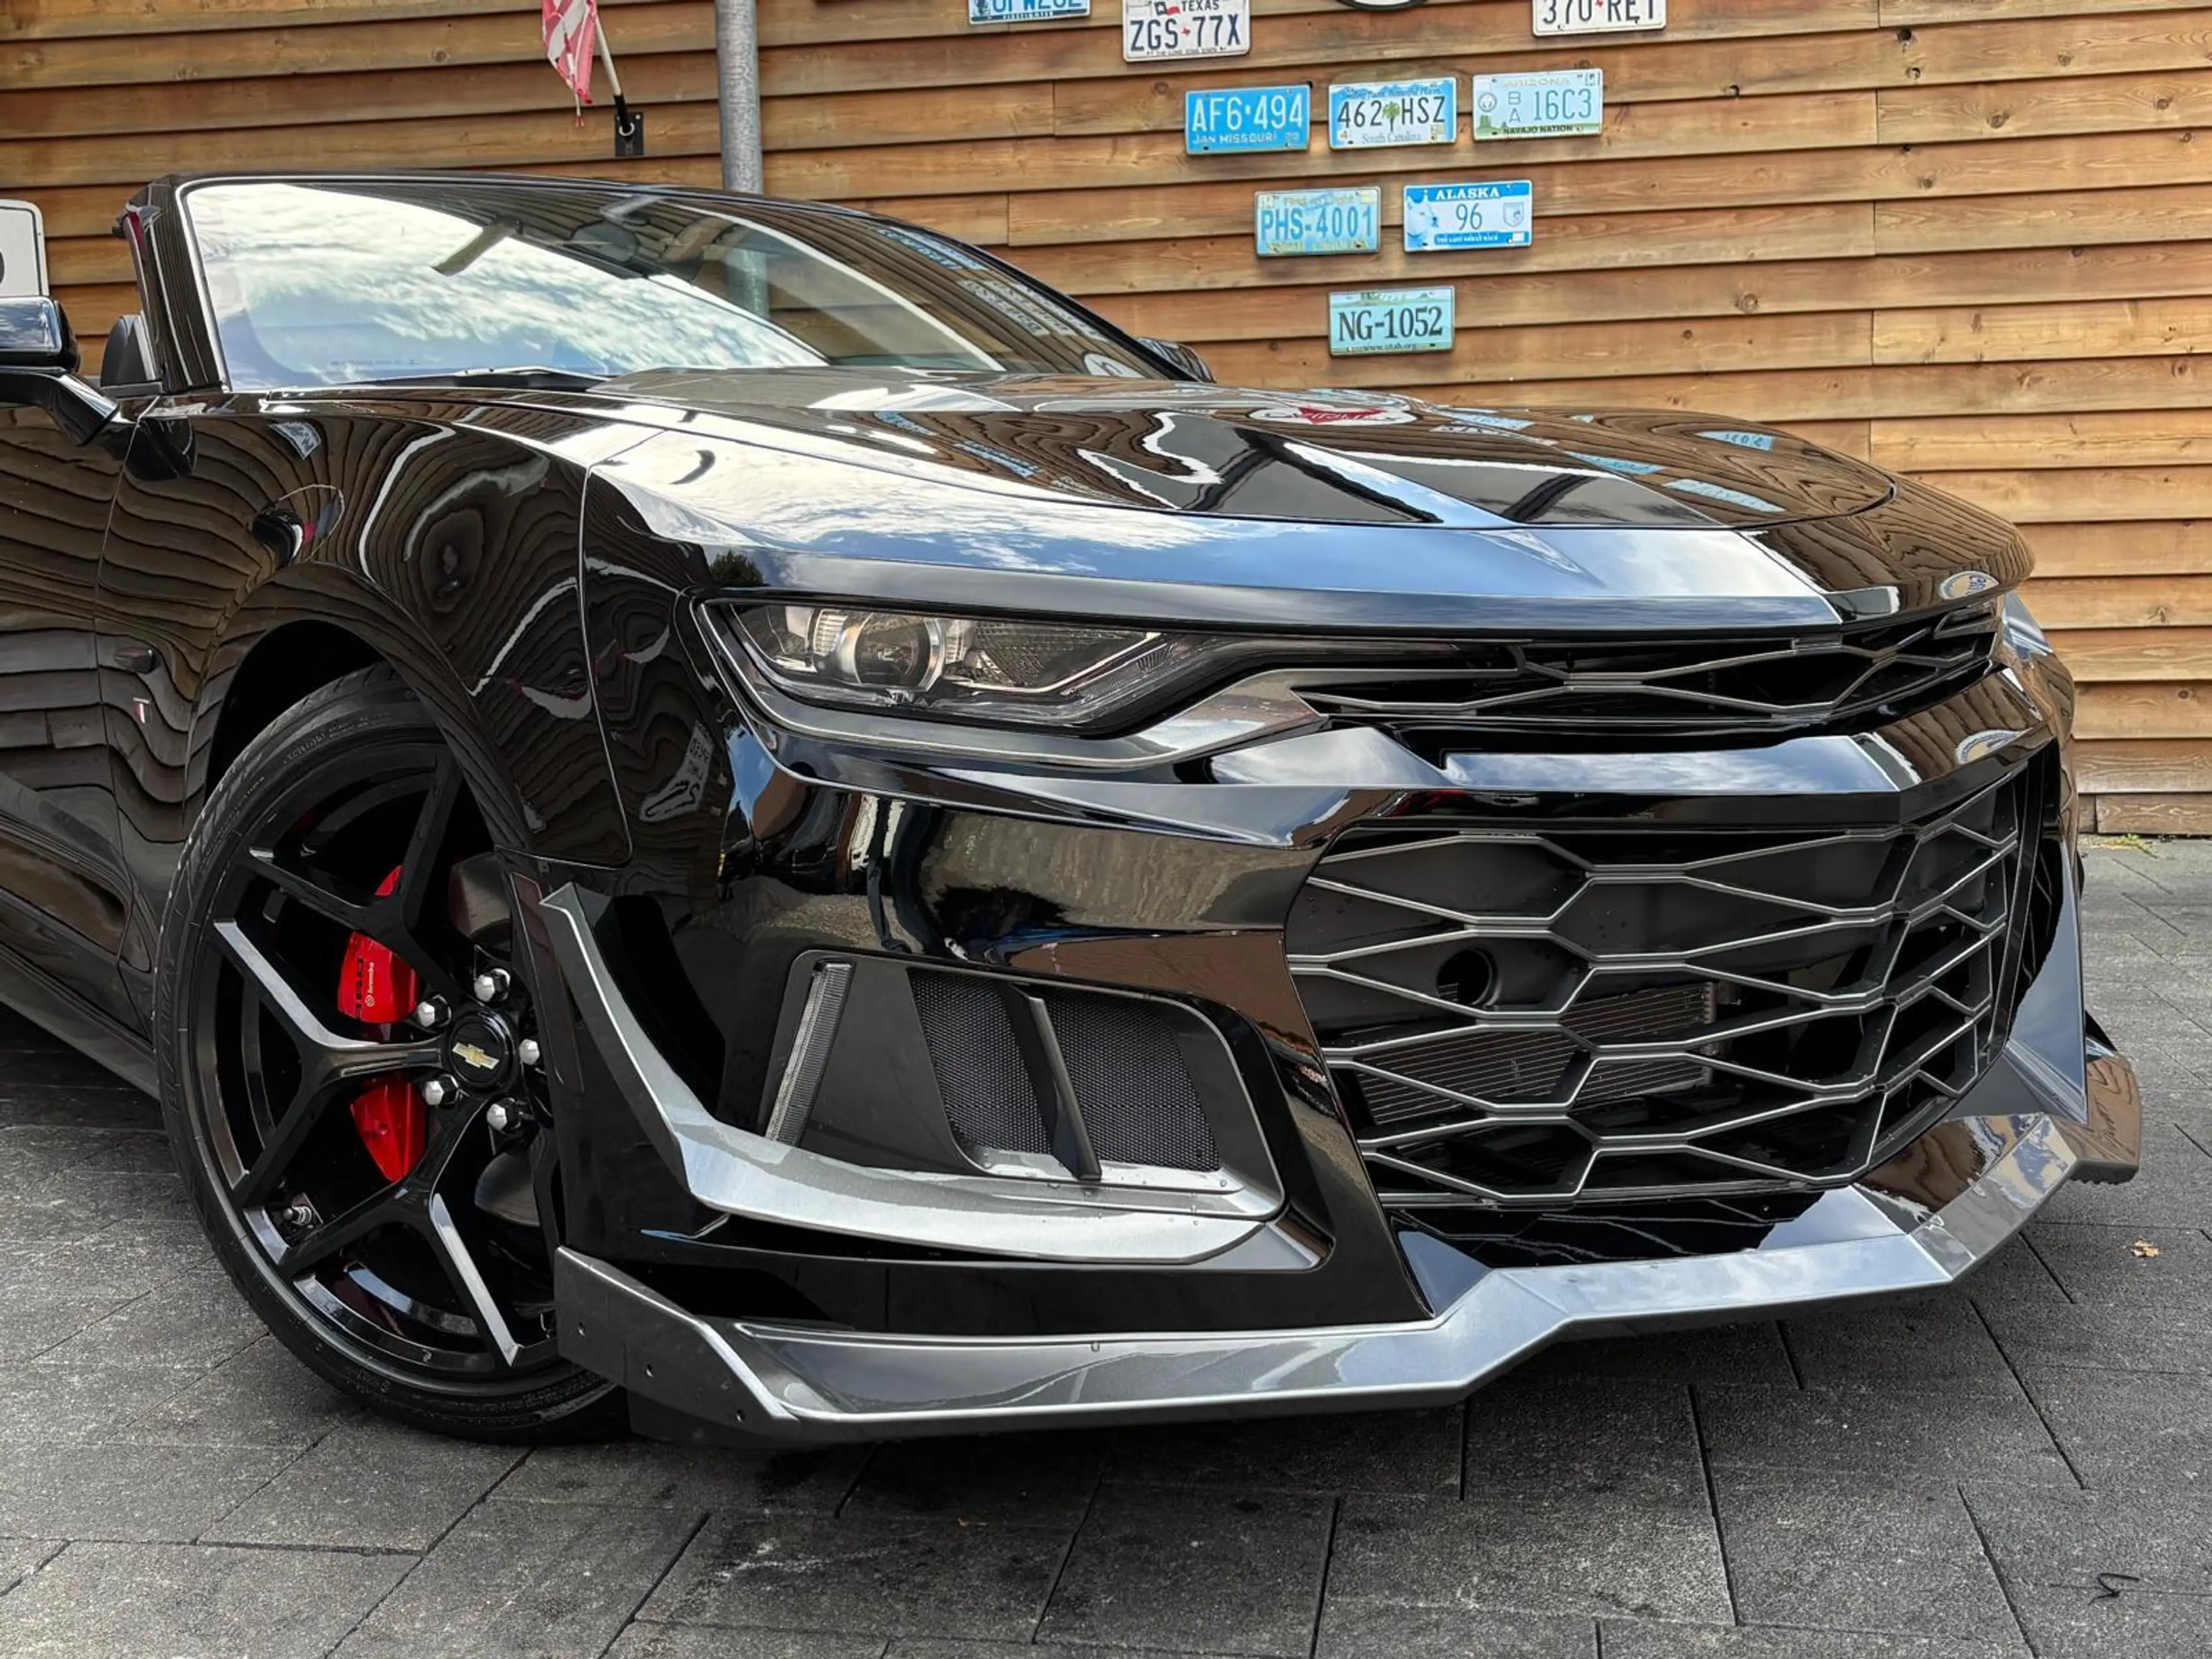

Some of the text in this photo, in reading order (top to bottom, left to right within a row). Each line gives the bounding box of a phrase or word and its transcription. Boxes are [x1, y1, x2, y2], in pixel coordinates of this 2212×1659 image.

[1181, 0, 1219, 12] TEXAS
[1130, 14, 1241, 52] ZGS 77X
[1504, 77, 1571, 86] ARIZONA
[1337, 96, 1445, 128] 462 HSZ
[1534, 88, 1592, 121] 16C3
[1219, 131, 1277, 144] MISSOURI
[1503, 124, 1573, 135] NAVAJO NATION
[1435, 187, 1499, 200] ALASKA
[1261, 204, 1372, 241] PHS-4001
[1455, 202, 1483, 230] 96
[1338, 305, 1443, 342] NG-1052
